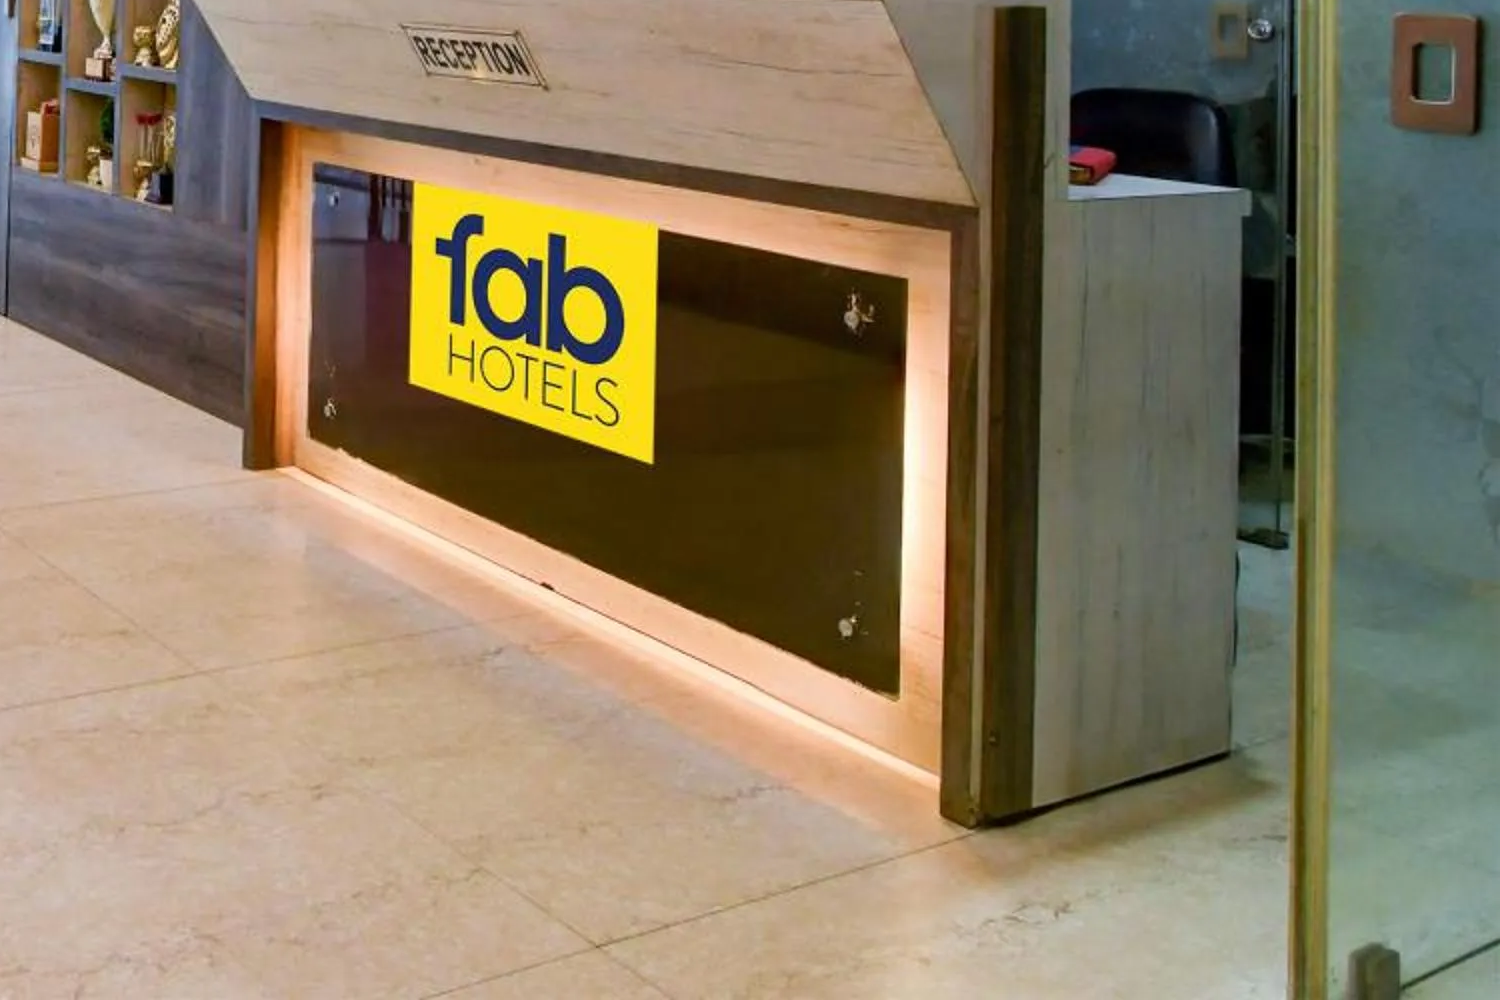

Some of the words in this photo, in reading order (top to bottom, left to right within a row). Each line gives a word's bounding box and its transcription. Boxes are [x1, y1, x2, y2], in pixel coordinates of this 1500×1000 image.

[412, 35, 531, 77] RECEPTION
[435, 213, 625, 365] fab
[449, 333, 620, 427] HOTELS
